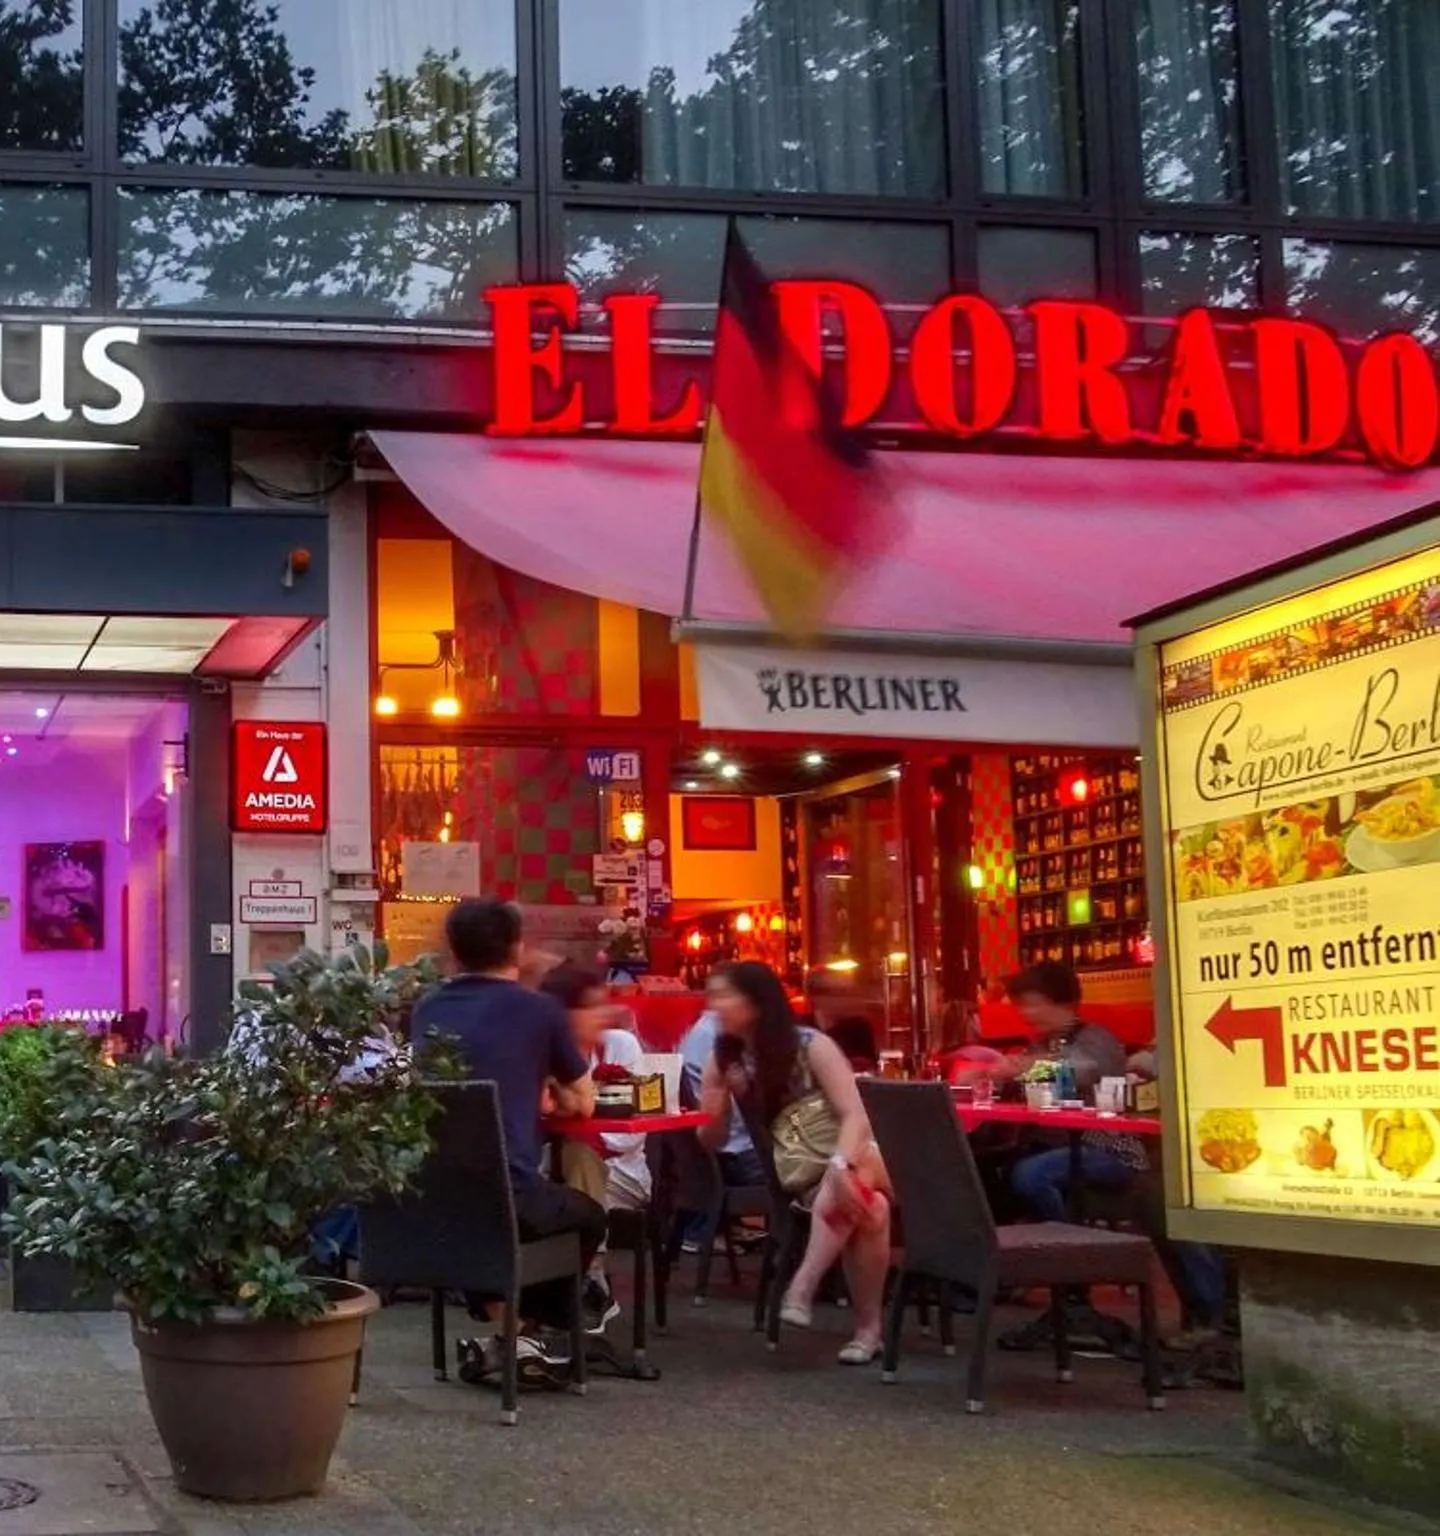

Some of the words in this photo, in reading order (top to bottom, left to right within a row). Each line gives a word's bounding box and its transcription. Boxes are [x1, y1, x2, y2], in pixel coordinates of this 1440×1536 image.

[481, 283, 706, 437] EL
[770, 279, 1438, 470] DORADO
[785, 671, 967, 715] BERLINER
[245, 792, 316, 809] AMEDIA
[332, 919, 354, 931] WC
[1199, 951, 1241, 982] nur
[1249, 940, 1279, 978] 50
[1288, 944, 1312, 974] m
[1322, 924, 1440, 970] entfern
[1289, 986, 1435, 1022] RESTAURANT
[1291, 1026, 1440, 1075] KNESE
[1293, 1085, 1351, 1100] BERLINER
